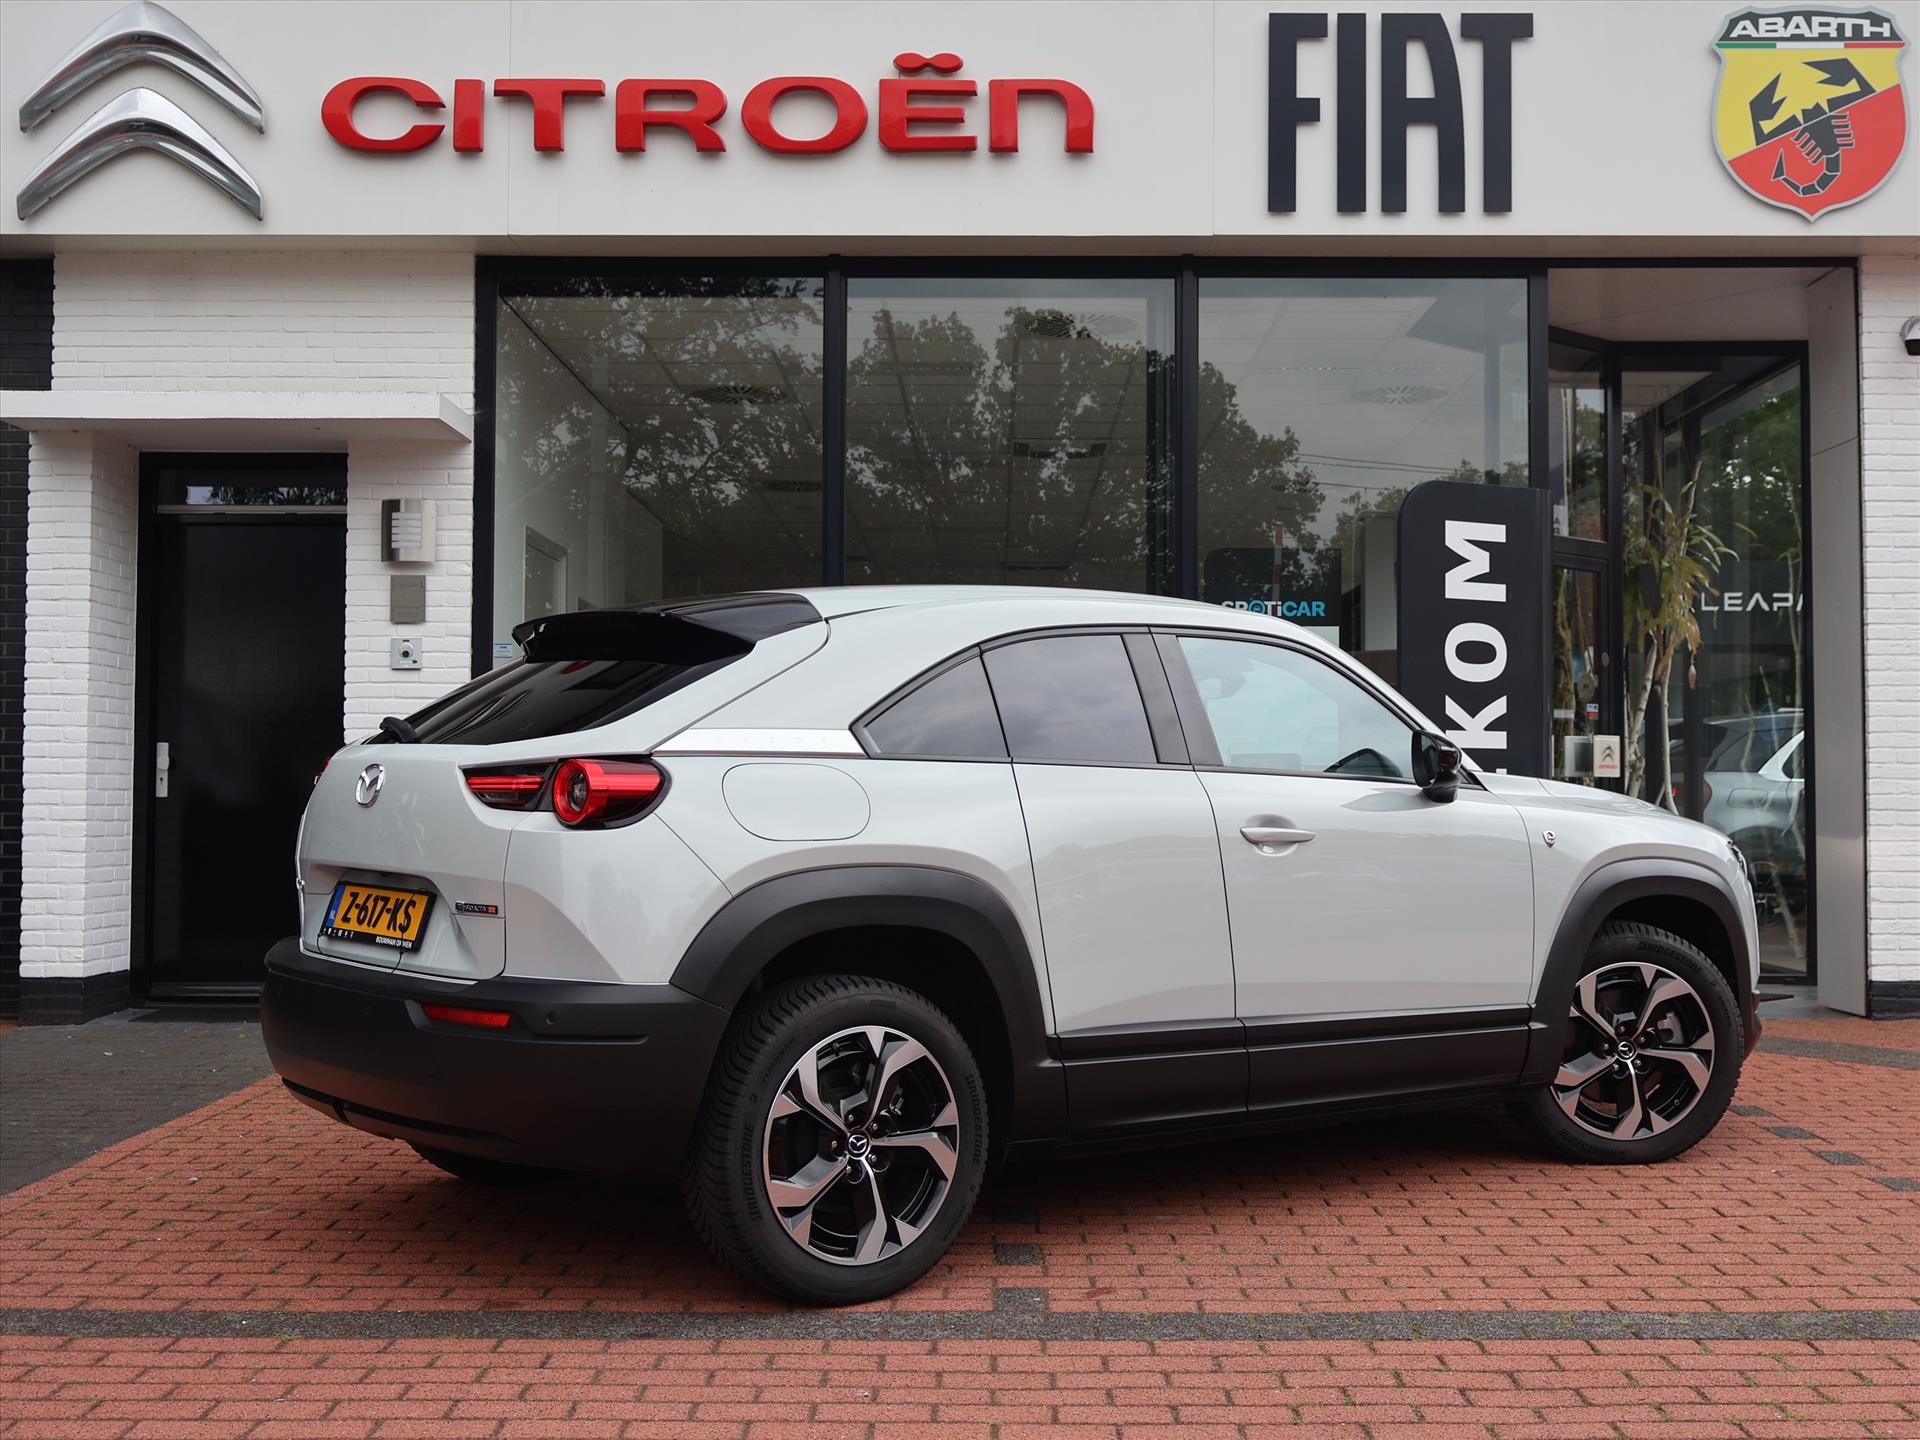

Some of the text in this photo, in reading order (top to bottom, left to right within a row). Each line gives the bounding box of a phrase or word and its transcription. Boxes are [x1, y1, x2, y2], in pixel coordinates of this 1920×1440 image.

[1729, 16, 1890, 38] ABARTH
[321, 52, 1094, 154] CITROËN
[1268, 12, 1533, 213] FIAT
[1444, 519, 1507, 775] KOM
[341, 892, 417, 933] Z-617-KS
[963, 1073, 983, 1167] BRIDGESTONE
[741, 1120, 763, 1224] BRIDGESTONE
